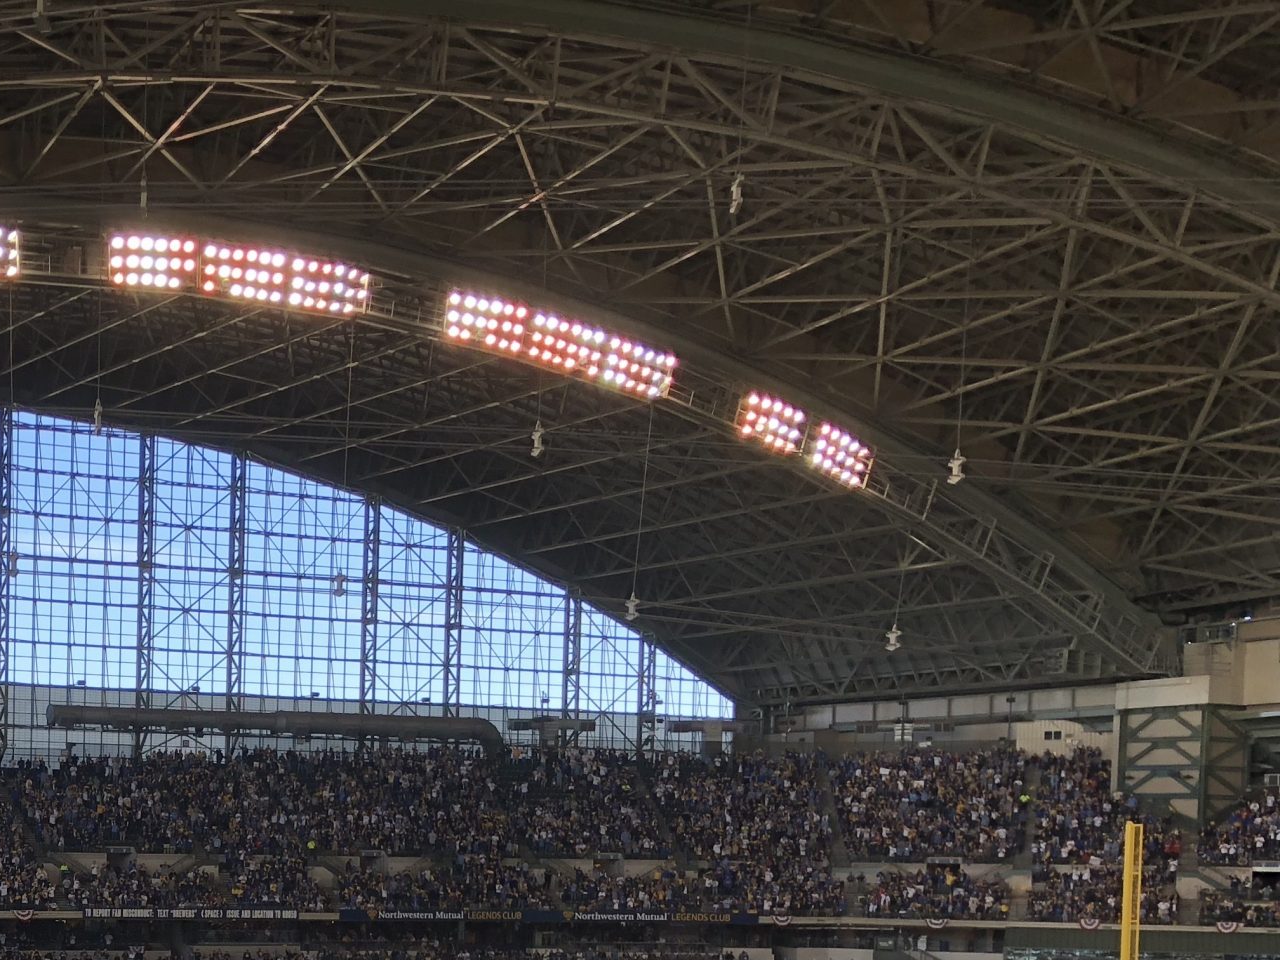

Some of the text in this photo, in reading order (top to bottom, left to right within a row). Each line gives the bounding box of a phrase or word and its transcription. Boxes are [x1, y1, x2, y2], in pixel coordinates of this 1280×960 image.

[93, 909, 110, 918] REPORT
[157, 909, 169, 918] TEXT
[241, 909, 251, 918] AND
[252, 909, 274, 918] LOCATION
[378, 911, 522, 920] Northwestern Mutual LEGENDS CLUB
[575, 912, 731, 922] Northwestern Mutual LEGENDS CLUB
